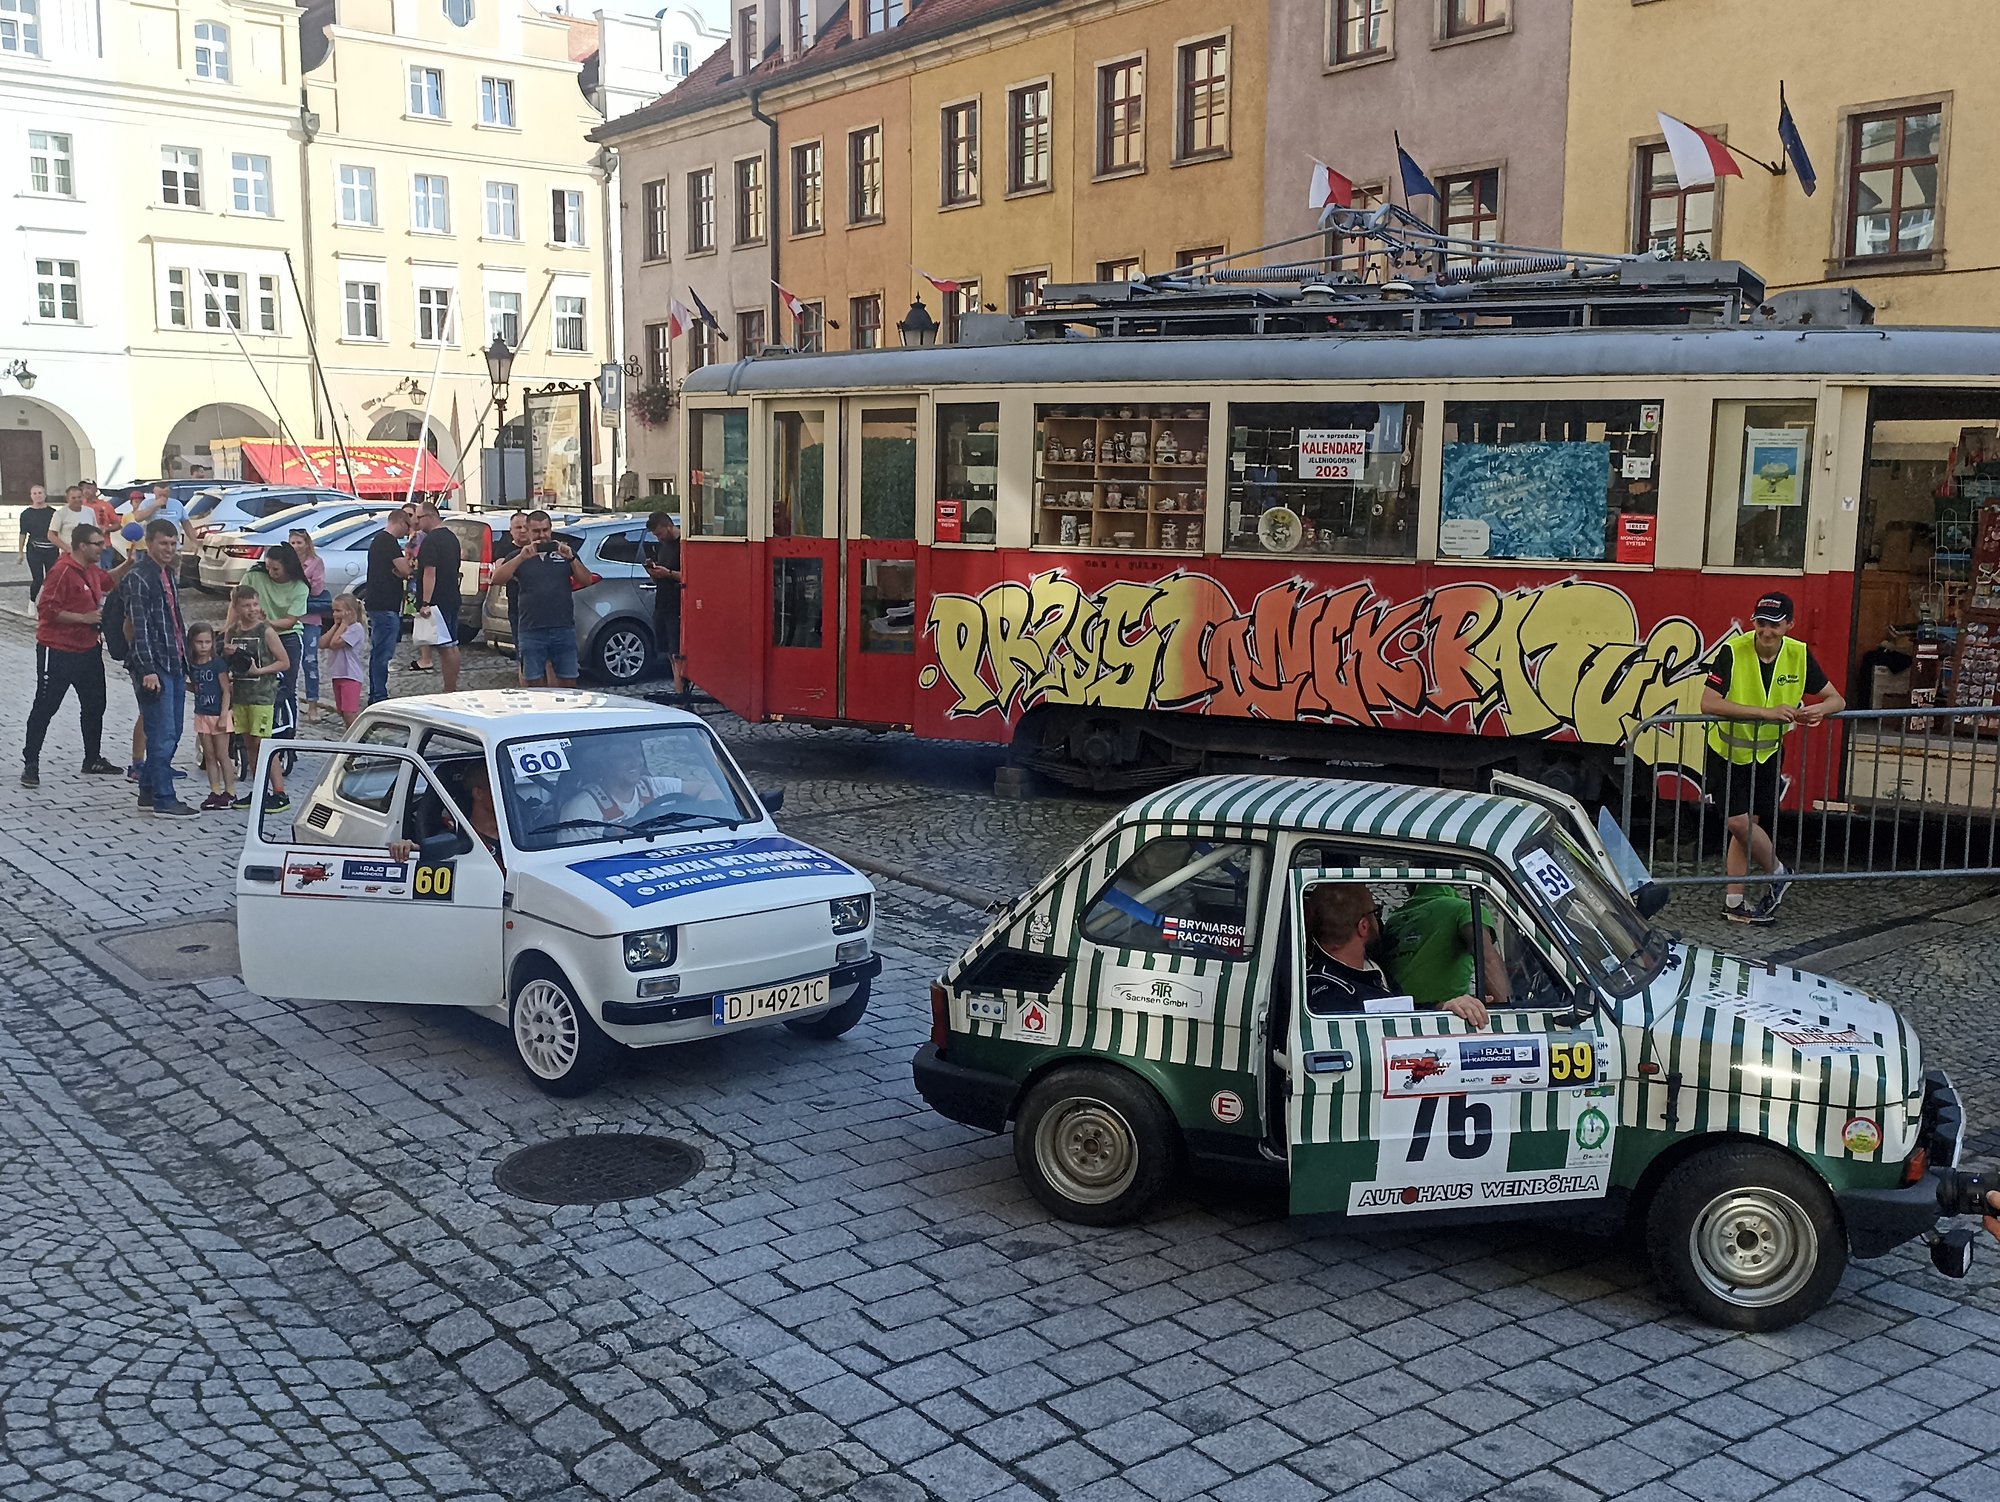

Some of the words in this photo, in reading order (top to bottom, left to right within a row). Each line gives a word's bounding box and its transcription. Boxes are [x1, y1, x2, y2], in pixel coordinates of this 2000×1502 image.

[605, 370, 617, 403] P
[1302, 442, 1364, 455] KALENDARZ
[1315, 465, 1348, 477] 2023
[519, 750, 562, 773] 60
[605, 857, 717, 888] POSADZKI
[716, 849, 823, 869] BETONOWE
[1535, 863, 1570, 896] 59
[415, 866, 451, 895] 60
[1178, 918, 1246, 937] BRYNIARSKI
[1177, 930, 1241, 948] RACZYŃSKI
[1126, 992, 1161, 1004] Sachsen
[1163, 999, 1188, 1008] GmbH
[1485, 1047, 1512, 1056] RAJD
[1551, 1041, 1592, 1080] 59
[1217, 1096, 1237, 1117] E
[1358, 1183, 1473, 1207] AUTOHAUS
[1482, 1174, 1600, 1199] WEINBÖHLA
